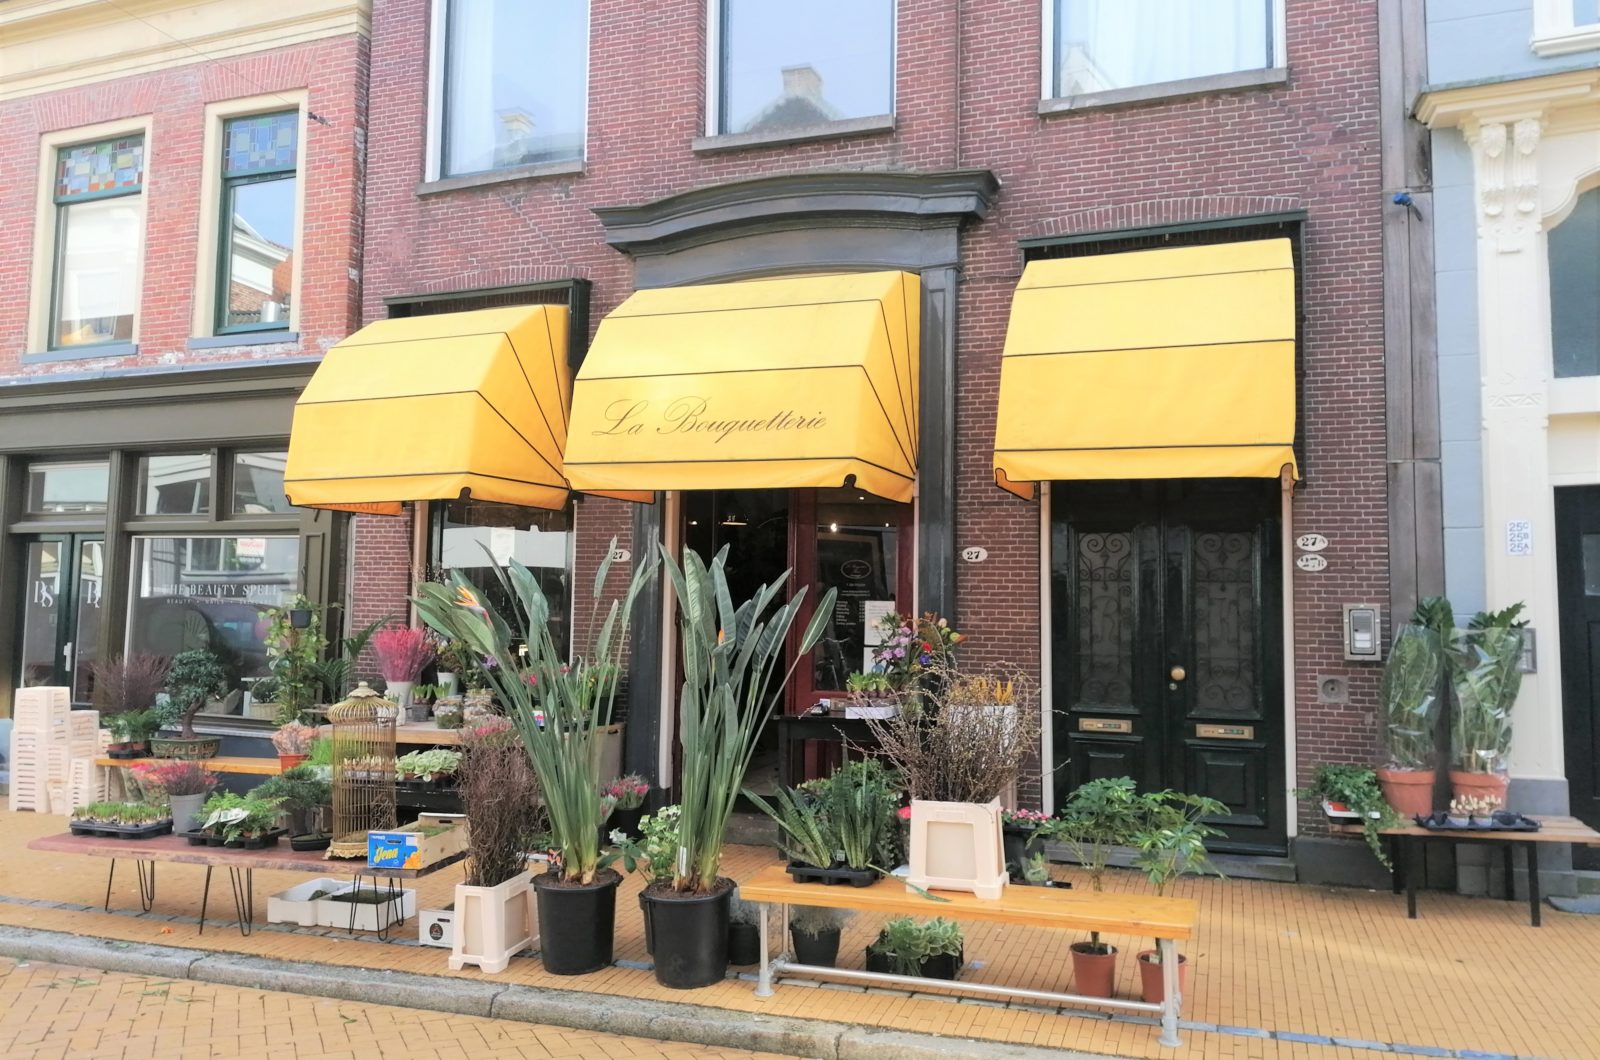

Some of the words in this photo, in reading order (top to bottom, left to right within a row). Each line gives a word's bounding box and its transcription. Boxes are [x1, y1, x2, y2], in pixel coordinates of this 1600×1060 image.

[592, 398, 649, 436] La
[656, 395, 827, 444] Bouquetterie
[613, 551, 624, 560] 27
[967, 551, 980, 560] 27
[190, 583, 238, 595] BEAUTY
